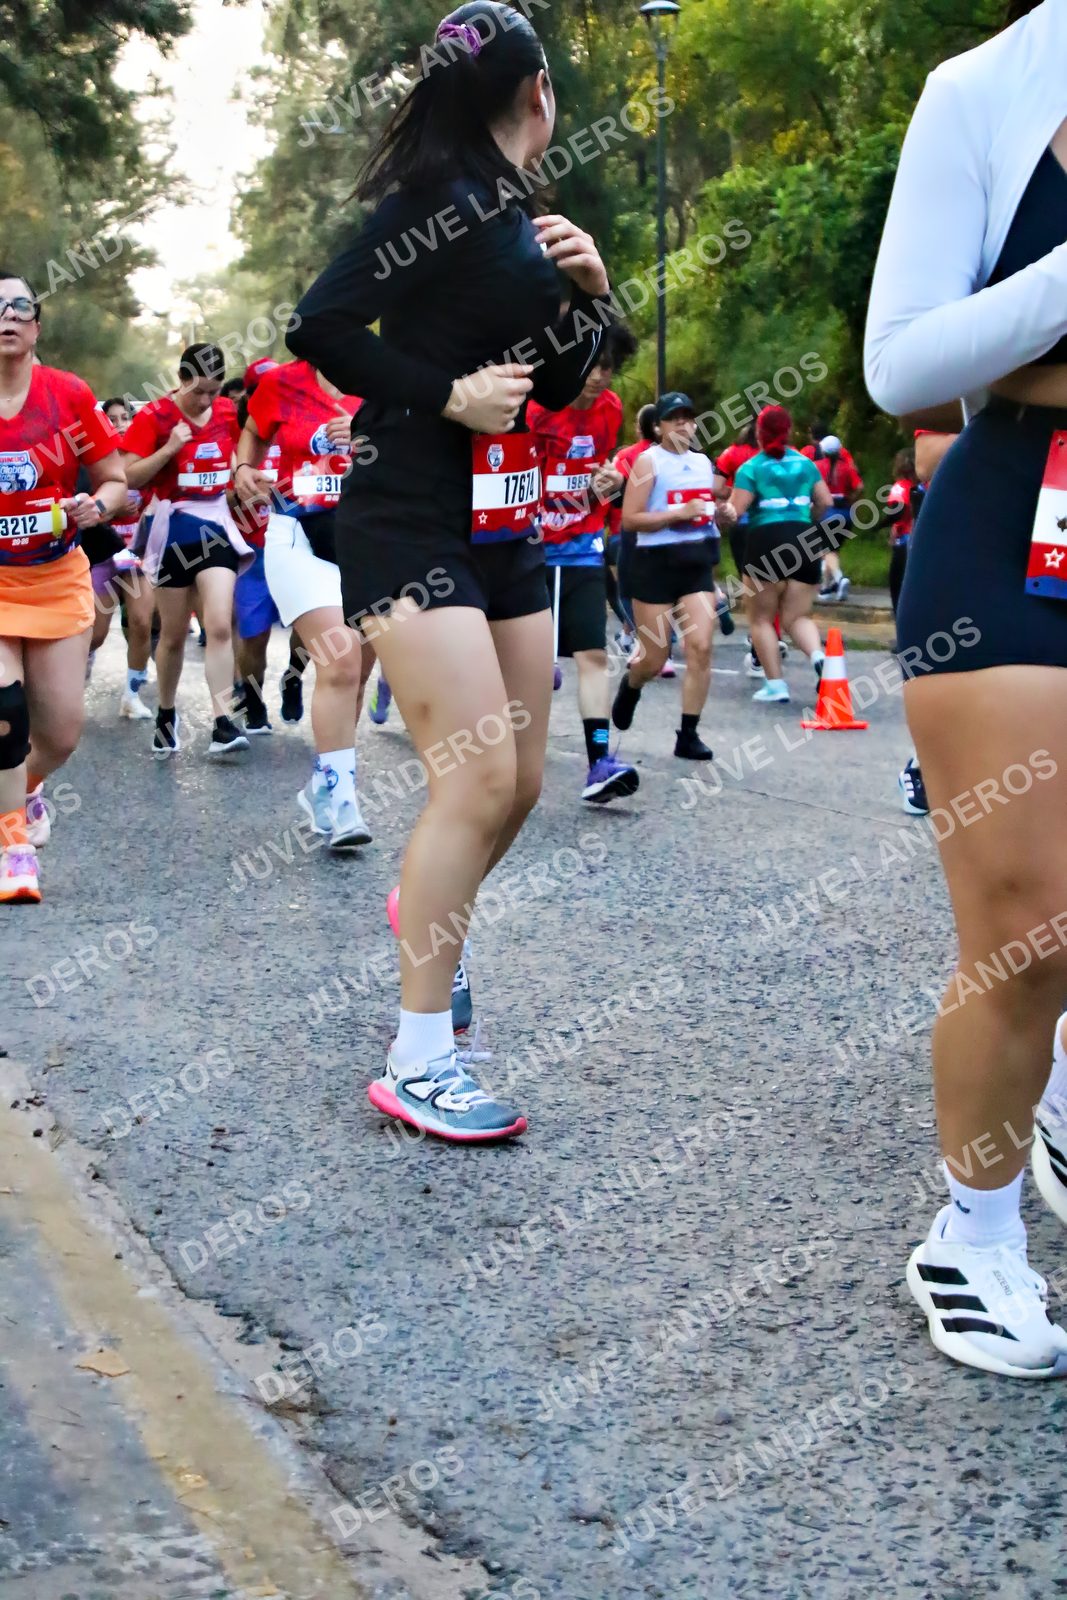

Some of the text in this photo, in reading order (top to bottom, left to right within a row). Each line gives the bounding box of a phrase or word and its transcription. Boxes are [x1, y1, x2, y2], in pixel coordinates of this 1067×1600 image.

[198, 472, 218, 485] 1212
[504, 472, 535, 504] 17674
[0, 515, 38, 536] 3212
